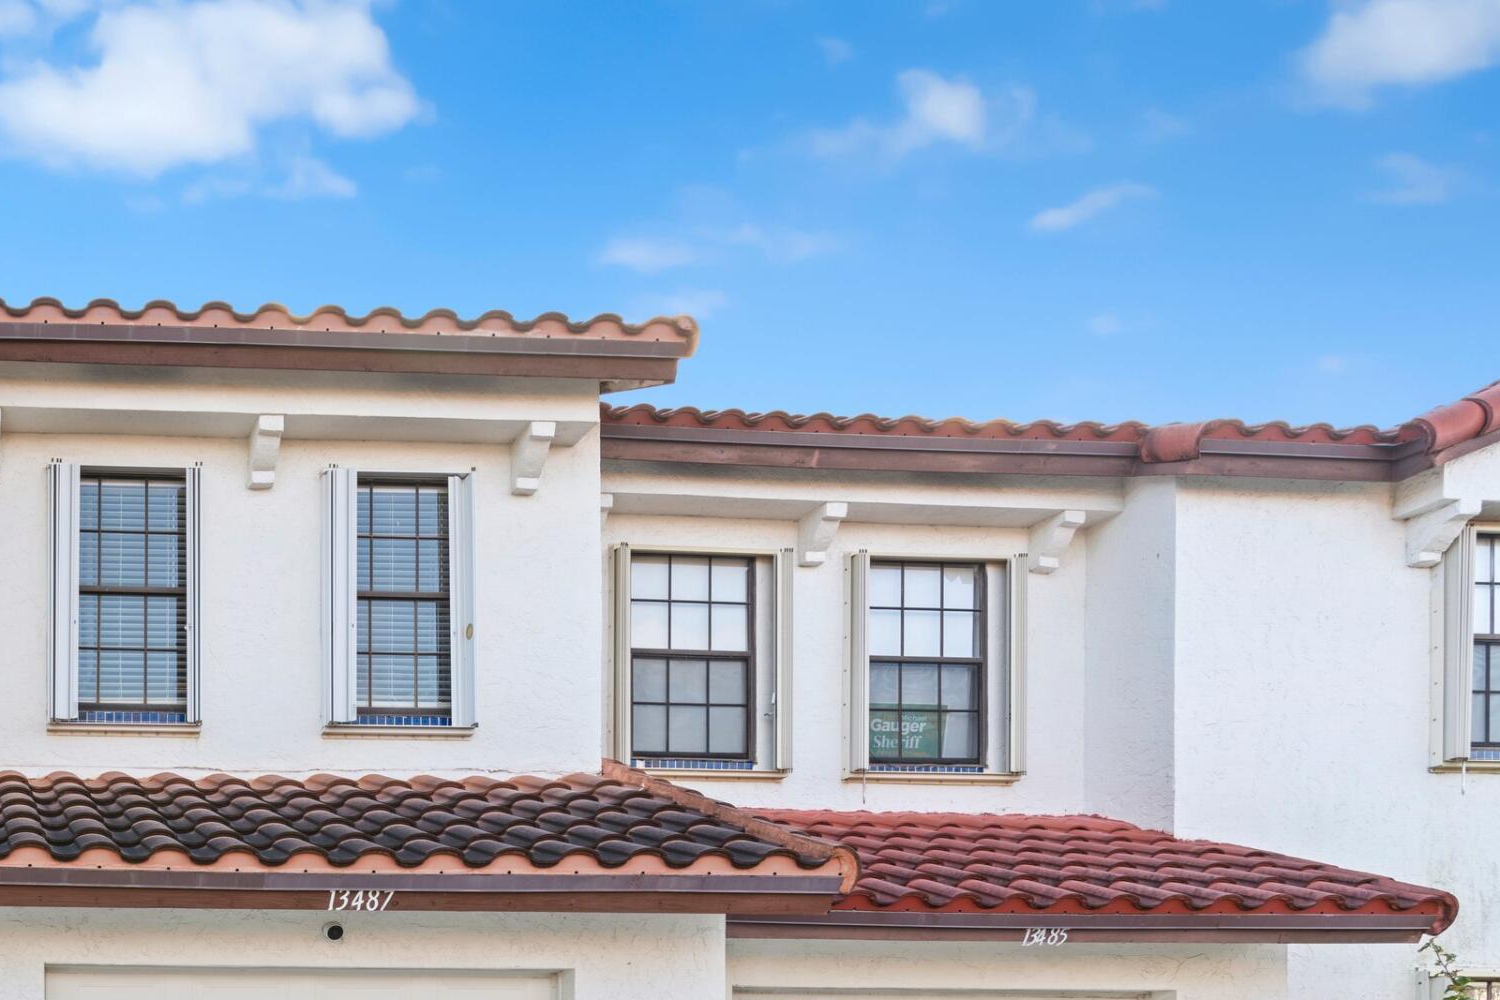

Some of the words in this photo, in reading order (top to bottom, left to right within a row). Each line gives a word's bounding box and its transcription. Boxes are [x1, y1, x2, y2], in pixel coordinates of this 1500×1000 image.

[870, 719, 927, 735] Gauger
[872, 735, 923, 749] Sheriff
[327, 889, 395, 912] 13487
[1021, 927, 1068, 946] 13485
